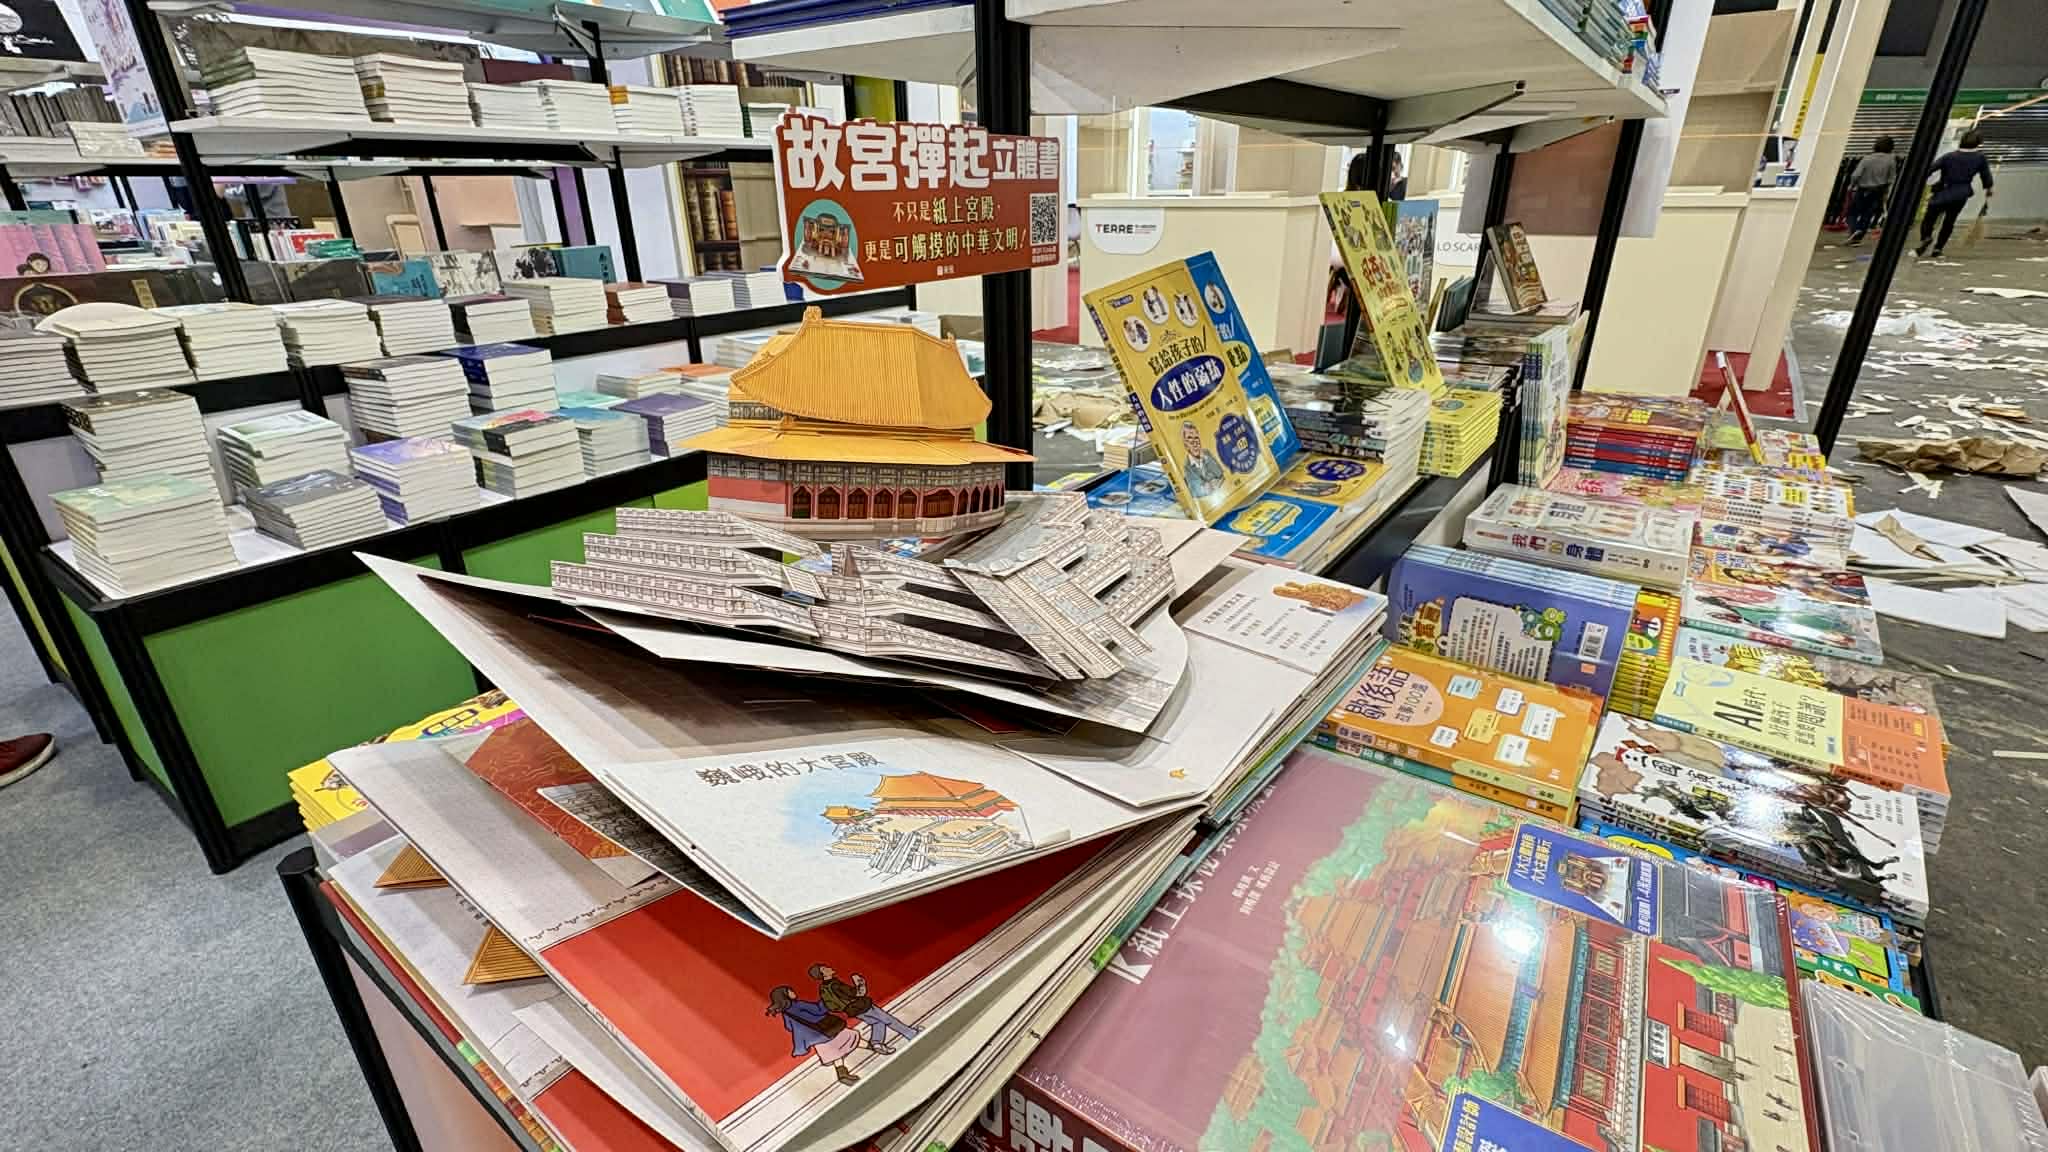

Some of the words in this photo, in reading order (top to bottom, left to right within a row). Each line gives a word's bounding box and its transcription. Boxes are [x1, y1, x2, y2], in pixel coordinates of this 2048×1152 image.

[1156, 357, 1223, 409] 人性的弱點
[1344, 664, 1411, 721] 歇後語
[696, 752, 885, 787] 巍峨的大宮殿
